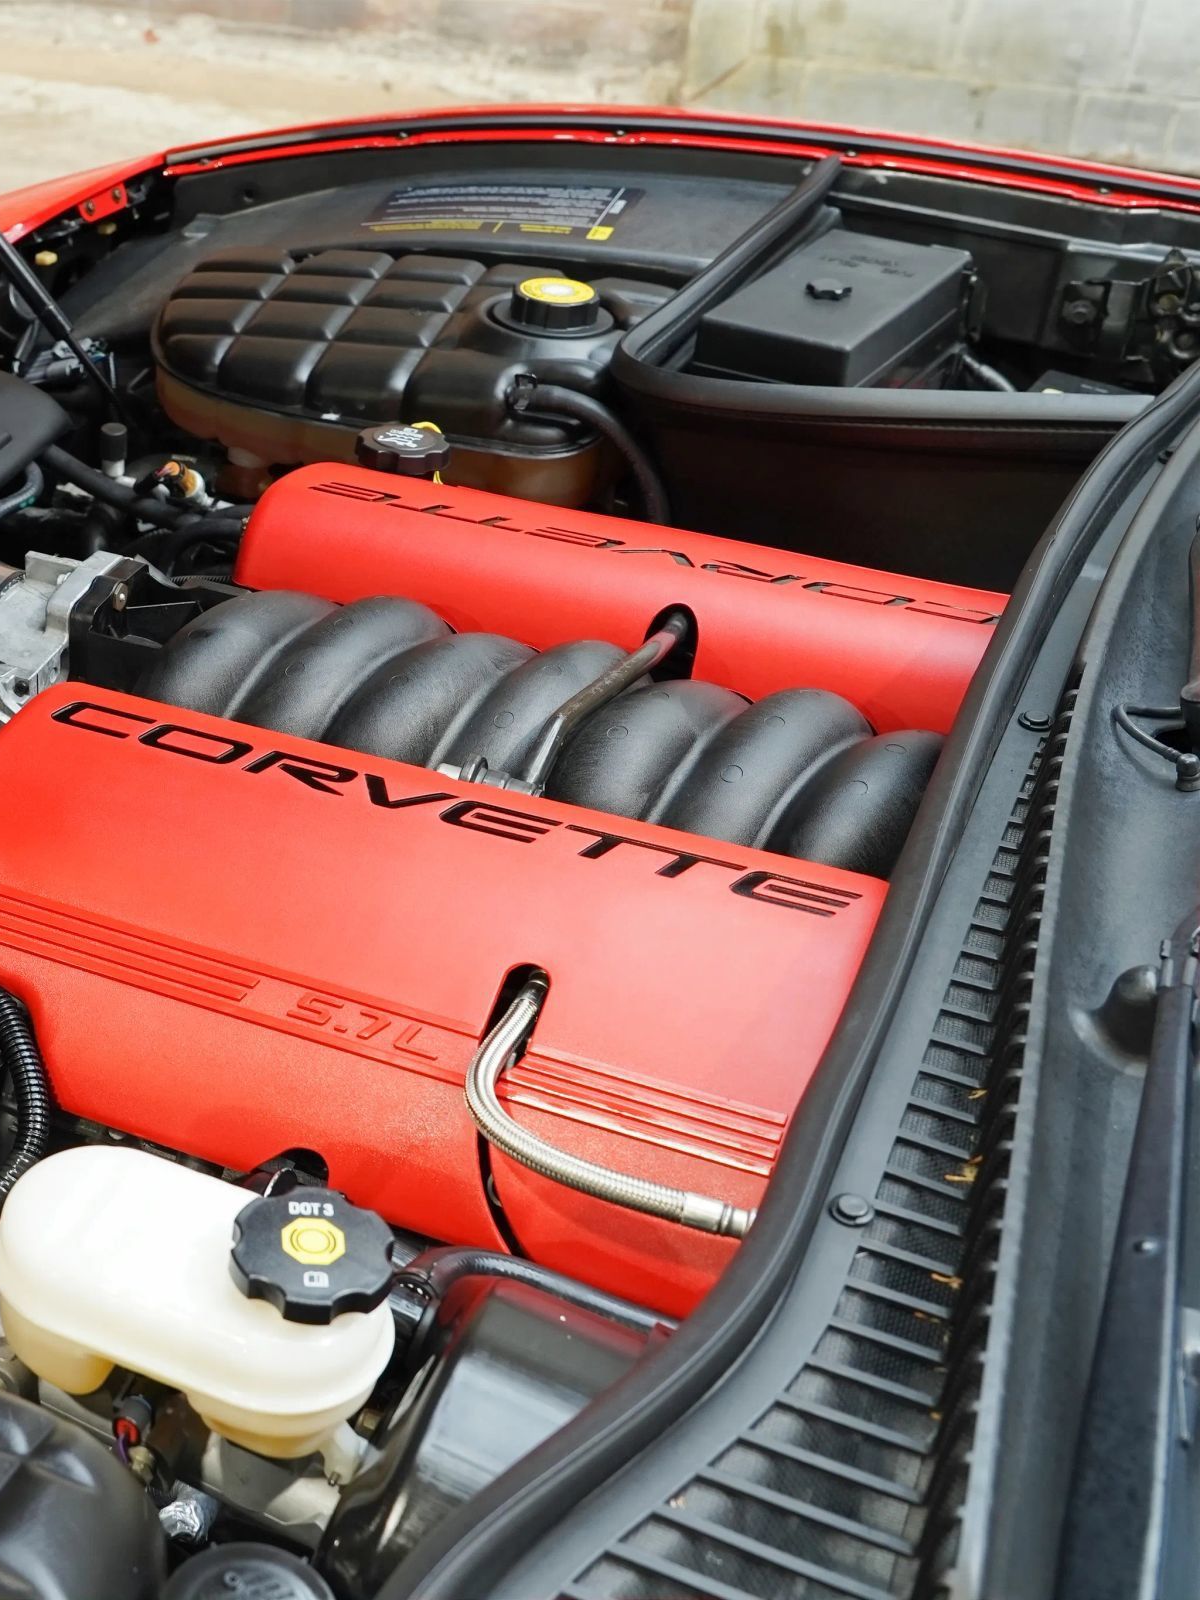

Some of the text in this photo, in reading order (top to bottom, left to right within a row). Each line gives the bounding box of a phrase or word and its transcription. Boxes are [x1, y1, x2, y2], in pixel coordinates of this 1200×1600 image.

[308, 482, 1000, 625] CORVETTE
[50, 701, 863, 918] CORVETTE
[286, 991, 438, 1062] 5.7L
[288, 1200, 335, 1217] DOT 3
